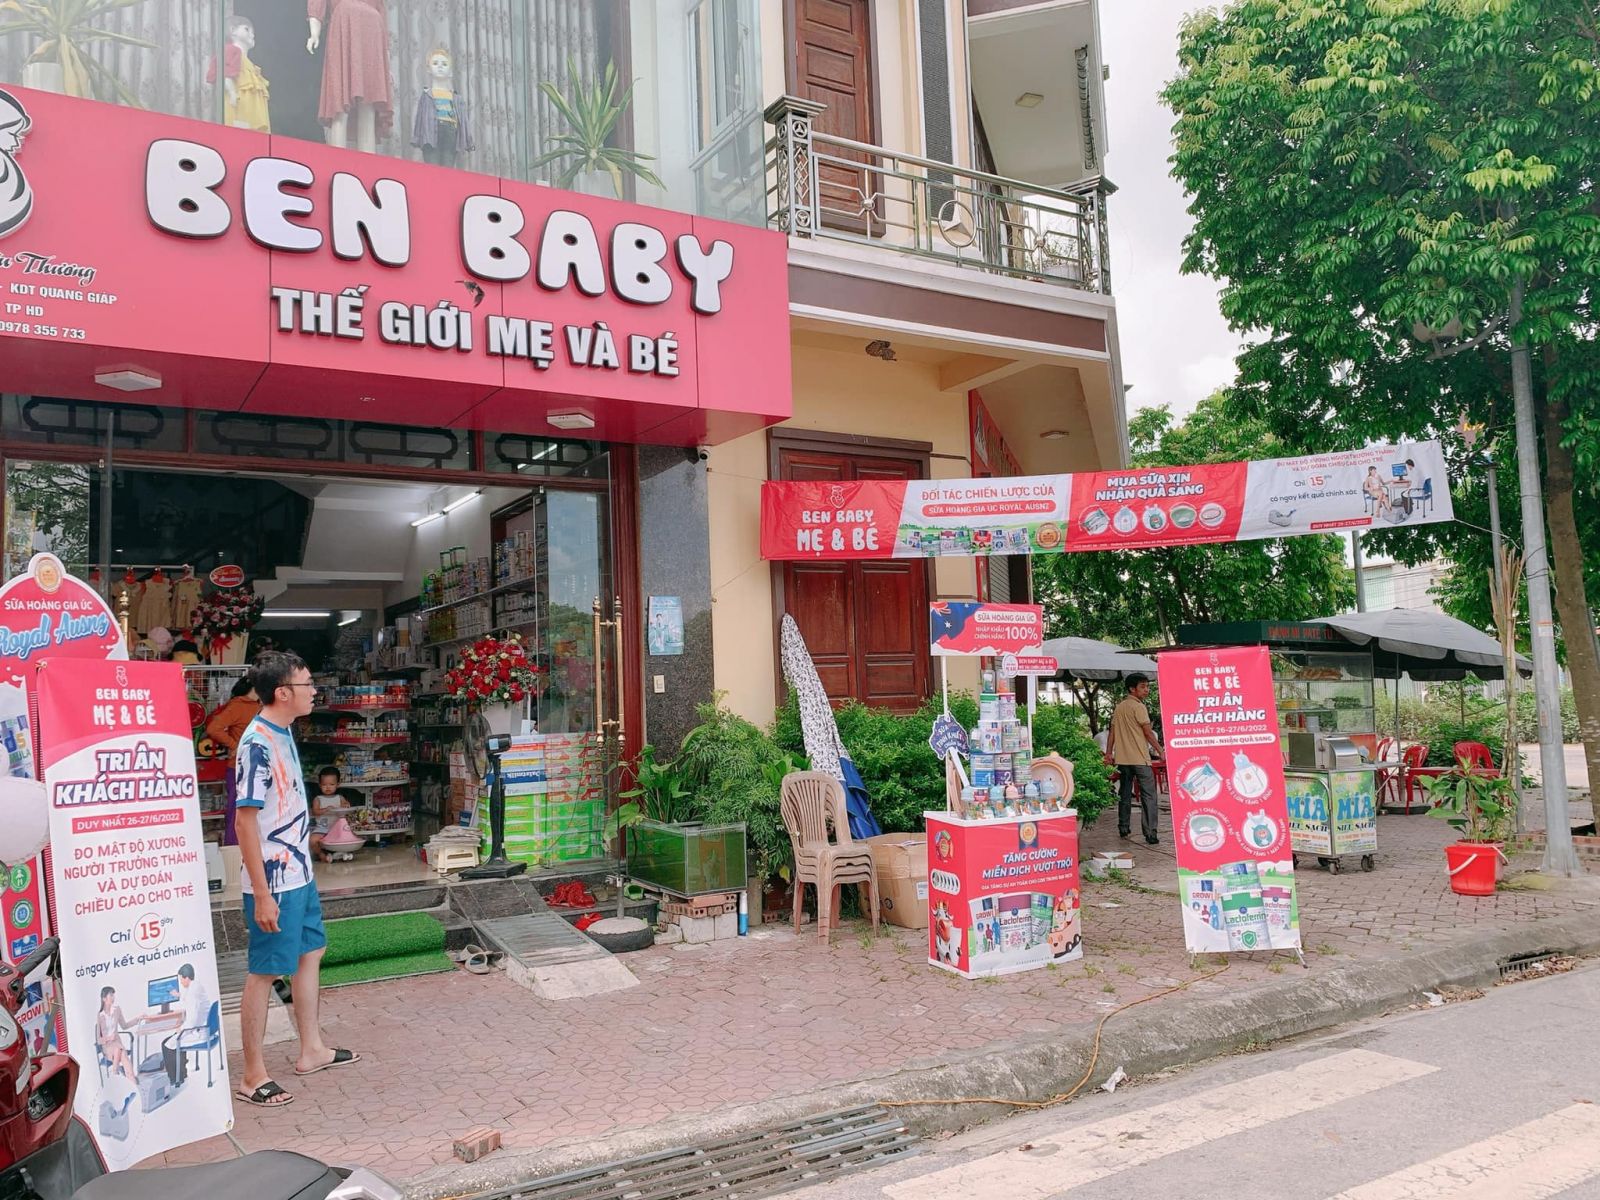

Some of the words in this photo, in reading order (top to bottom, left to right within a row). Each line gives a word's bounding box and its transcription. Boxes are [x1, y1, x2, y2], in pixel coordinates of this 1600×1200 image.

[146, 139, 411, 268] BEN
[460, 194, 734, 314] BABY
[39, 286, 83, 301] QUANG
[5, 303, 22, 314] TP
[26, 305, 44, 316] HD
[34, 324, 58, 337] 355
[62, 327, 86, 339] 733
[272, 284, 370, 341] THẾ
[378, 301, 473, 353] GIỚI
[485, 315, 554, 370] MẸ
[564, 322, 621, 369] VÀ
[628, 332, 680, 377] BÉ
[1107, 477, 1138, 488] MUA
[1139, 473, 1167, 485] SỮA
[1168, 473, 1191, 485] XỊN
[1310, 476, 1324, 486] 15
[922, 489, 940, 501] ĐỐI
[943, 486, 962, 500] TÁC
[965, 486, 998, 499] CHIẾN
[1001, 485, 1030, 499] LƯỢC
[1033, 483, 1056, 496] CỦA
[1095, 488, 1135, 503] NHẬN
[1168, 484, 1204, 497] SANG
[802, 510, 831, 523] BEN
[836, 510, 874, 523] BABY
[973, 505, 986, 513] GIA
[797, 529, 824, 557] MẸ
[831, 528, 845, 551] &
[852, 522, 879, 551] BÉ
[4, 597, 26, 611] SỮA
[27, 597, 61, 611] HOÀNG
[63, 600, 79, 610] GIA
[80, 598, 93, 611] ÚC
[977, 613, 990, 621] SỮA
[992, 613, 1014, 622] HOÀNG
[1005, 626, 1039, 640] 100%
[1195, 666, 1212, 675] BEN
[1215, 665, 1236, 674] BABY
[1193, 677, 1210, 693] MẸ
[1213, 677, 1221, 689] &
[1225, 672, 1240, 689] BÉ
[96, 689, 119, 700] BEN
[122, 689, 151, 700] BABY
[1198, 697, 1220, 708] TRI
[1222, 692, 1243, 706] ÂN
[93, 705, 116, 730] MẸ
[120, 705, 132, 725] &
[135, 700, 157, 725] BÉ
[1173, 709, 1223, 725] KHÁCH
[1226, 706, 1266, 722] HÀNG
[1175, 728, 1192, 736] DUY
[1193, 725, 1215, 735] NHẤT
[1216, 725, 1267, 734] 26-27/6/2022
[97, 751, 132, 773] TRI
[133, 742, 165, 771] ÂN
[54, 773, 136, 808] KHÁCH
[138, 771, 194, 800] HÀNG
[1287, 792, 1328, 821] MÍA
[1337, 792, 1375, 821] MÍA
[77, 820, 99, 831] DUY
[102, 815, 126, 828] NHẤT
[127, 812, 180, 826] 26-27/6/2022
[74, 847, 93, 860] ĐO
[98, 842, 126, 858] MẬT
[129, 838, 145, 855] ĐỘ
[148, 836, 186, 851] XƯƠNG
[1002, 851, 1027, 864] TĂNG
[1029, 847, 1058, 861] CƯỜNG
[64, 862, 105, 880] NGƯỜI
[109, 855, 159, 874] TRƯỞNG
[161, 851, 198, 866] THÀNH
[1009, 864, 1031, 877] DỊCH
[1033, 862, 1055, 874] VƯỢT
[97, 877, 117, 893] VÀ
[121, 876, 140, 891] DỰ
[142, 870, 173, 887] ĐOÁN
[75, 895, 114, 916] CHIỀU
[118, 893, 145, 908] CAO
[148, 889, 172, 903] CHO
[174, 882, 194, 898] TRẺ
[1224, 911, 1266, 924] Lactoferrin
[110, 929, 131, 944] Chỉ
[140, 920, 161, 940] 15
[75, 965, 85, 978] có
[85, 961, 111, 978] ngay
[113, 953, 134, 969] kết
[137, 948, 161, 965] quả
[163, 943, 190, 958] chính
[191, 940, 207, 953] xác
